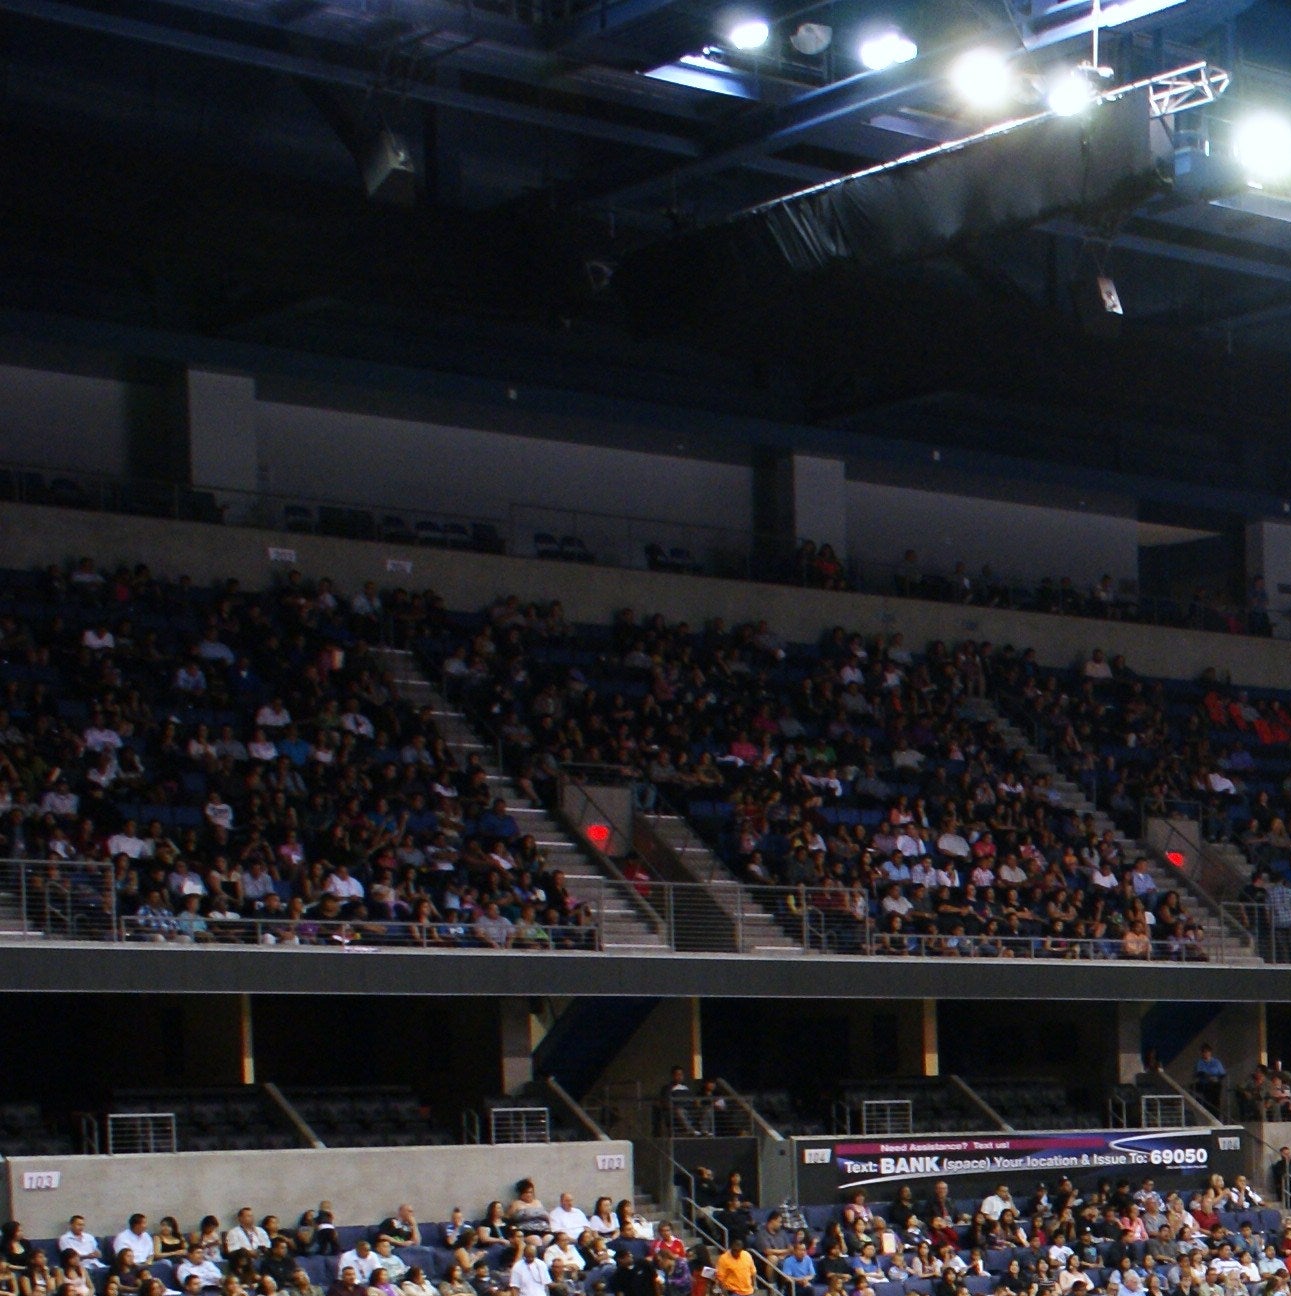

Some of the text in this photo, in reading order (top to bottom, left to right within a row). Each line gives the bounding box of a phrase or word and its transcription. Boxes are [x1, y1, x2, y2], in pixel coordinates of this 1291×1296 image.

[880, 1141, 1010, 1152] Need Assistance? Text us!
[844, 1148, 1208, 1174] Text: BANK (space) Your location & Issue To: 69050
[27, 1175, 54, 1190] 103
